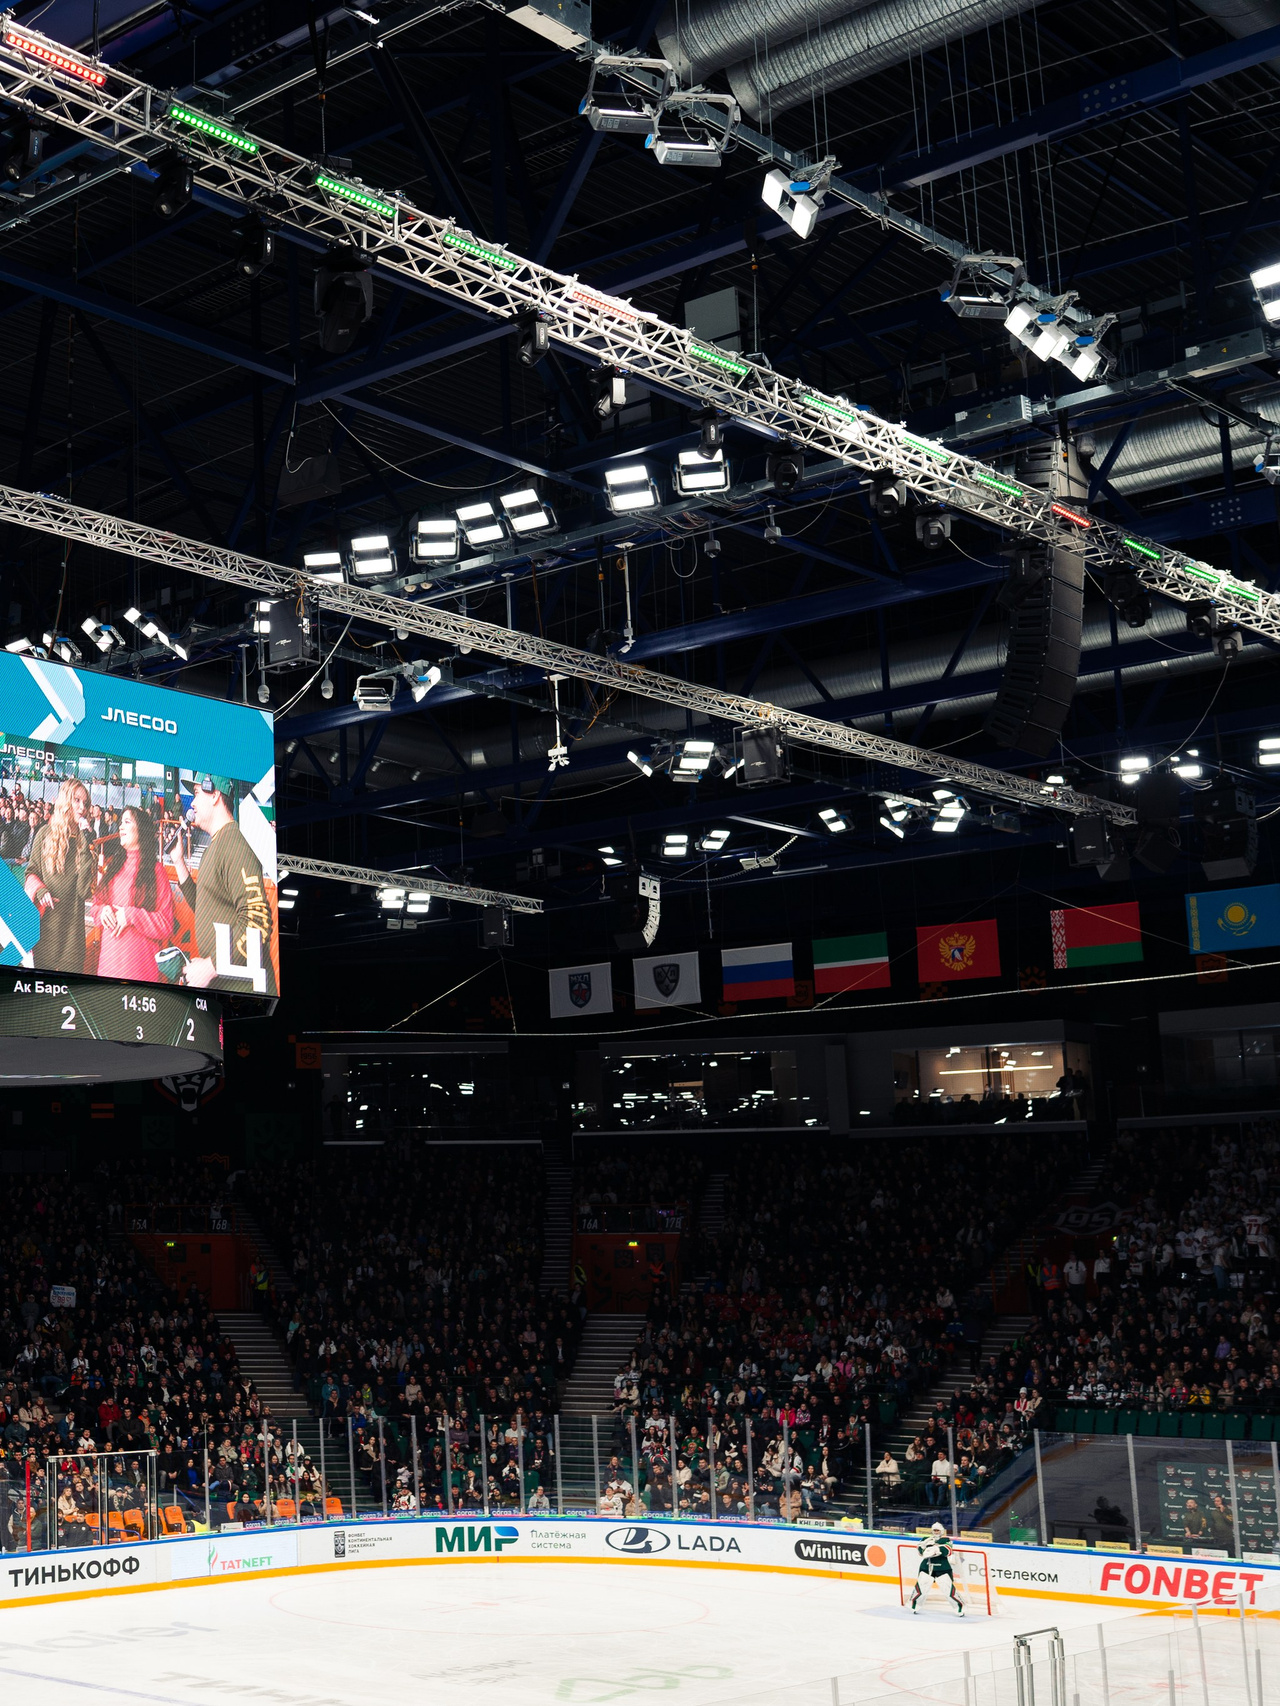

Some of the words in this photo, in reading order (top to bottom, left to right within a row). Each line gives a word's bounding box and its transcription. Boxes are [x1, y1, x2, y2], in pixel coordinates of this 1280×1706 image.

[101, 706, 179, 736] JAECOO
[13, 980, 32, 993] Ак
[35, 981, 68, 996] Барс
[121, 995, 156, 1013] 14:56
[60, 1006, 76, 1031] 2
[136, 1026, 144, 1040] 3
[186, 1018, 195, 1041] 2
[435, 1525, 519, 1553] МИР
[530, 1528, 587, 1539] Платёжная
[677, 1534, 742, 1553] LADA
[531, 1540, 572, 1549] система
[800, 1542, 862, 1563] Winline
[8, 1555, 140, 1588] ТИНЬКОФФ
[220, 1555, 273, 1571] TATNEFT
[1099, 1561, 1264, 1606] FONBET
